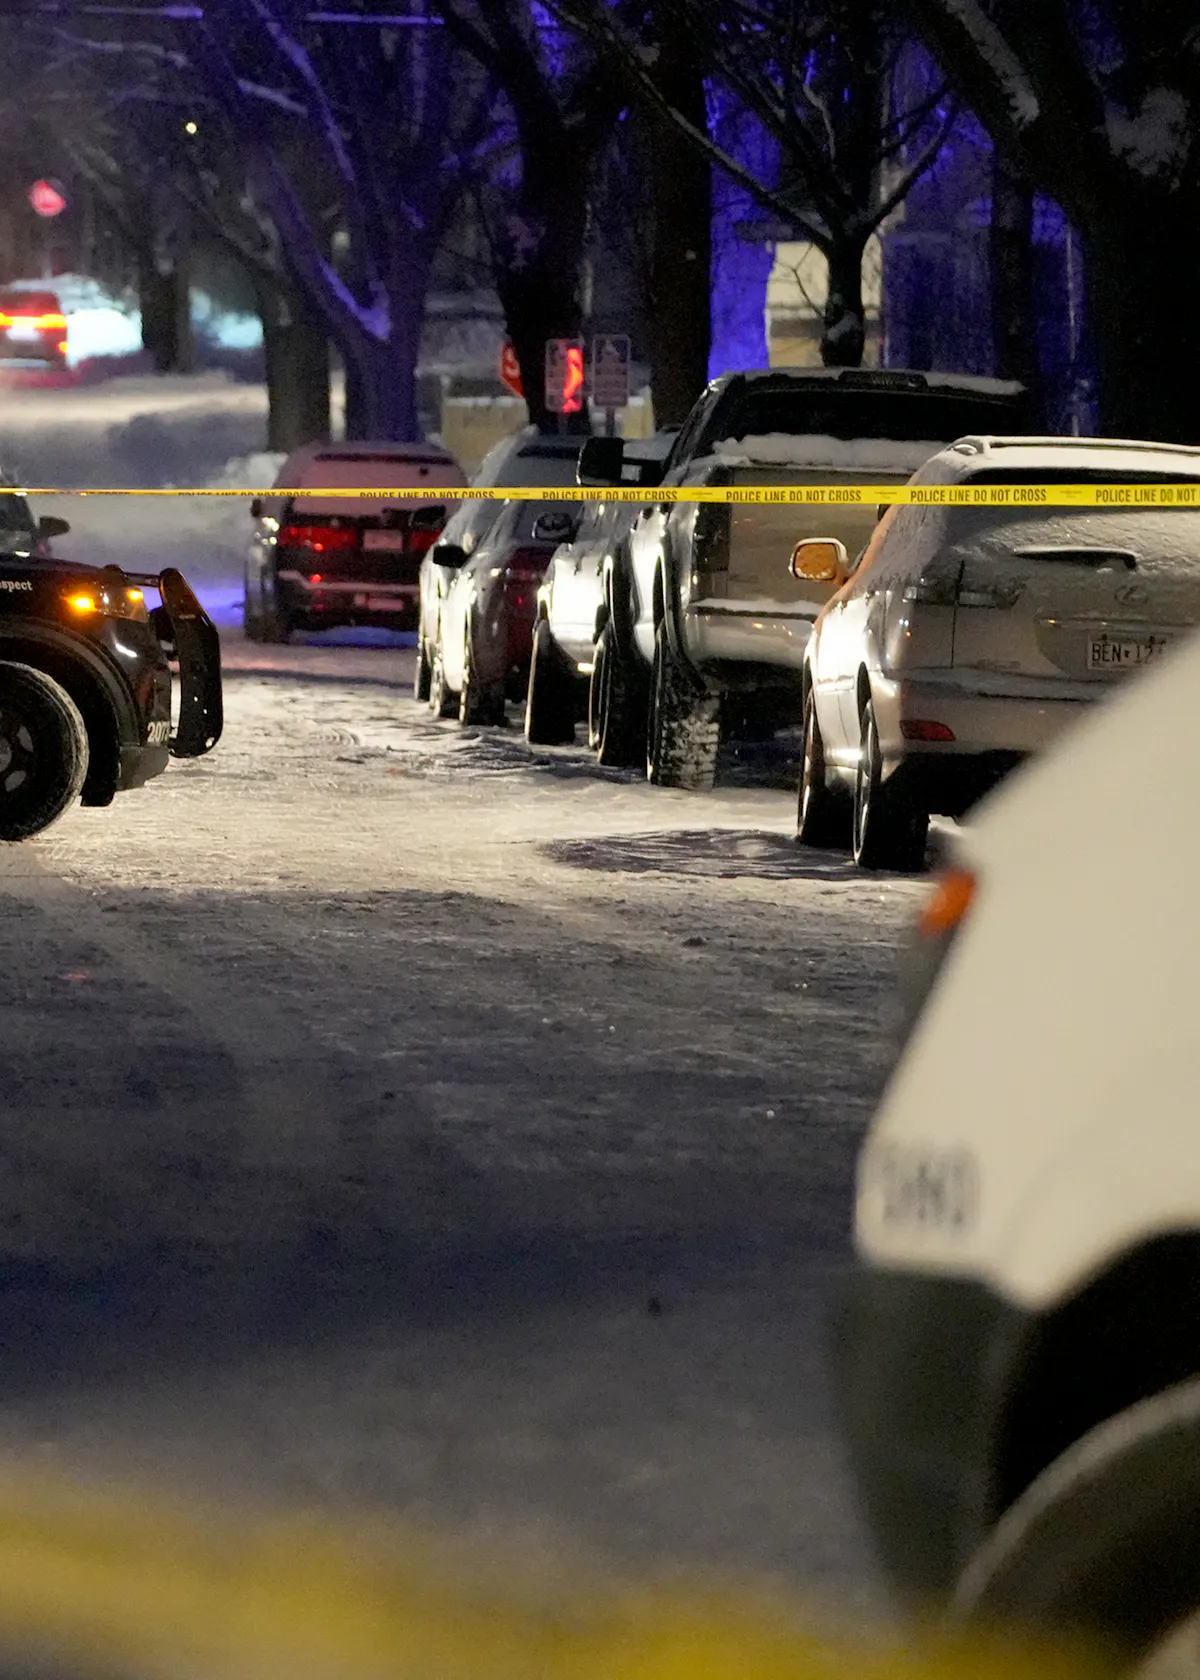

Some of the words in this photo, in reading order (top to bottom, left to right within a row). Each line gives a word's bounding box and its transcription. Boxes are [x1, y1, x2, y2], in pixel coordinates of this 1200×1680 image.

[542, 490, 578, 500] POLICE
[581, 490, 601, 500] LINE
[605, 490, 619, 500] DO
[622, 490, 642, 500] NOT
[644, 490, 678, 500] CROSS
[726, 491, 761, 501] POLICE
[765, 490, 786, 501] LINE
[789, 490, 803, 501] DO
[806, 489, 826, 501] NOT
[828, 489, 862, 501] CROSS
[910, 490, 945, 502] POLICE
[948, 490, 970, 502] LINE
[973, 490, 987, 502] DO
[990, 489, 1010, 502] NOT
[1013, 488, 1047, 502] CROSS
[1095, 489, 1131, 503] POLICE
[1134, 489, 1156, 502] LINE
[1159, 489, 1174, 502] DO
[1176, 488, 1196, 502] NOT
[1092, 643, 1121, 662] BEN
